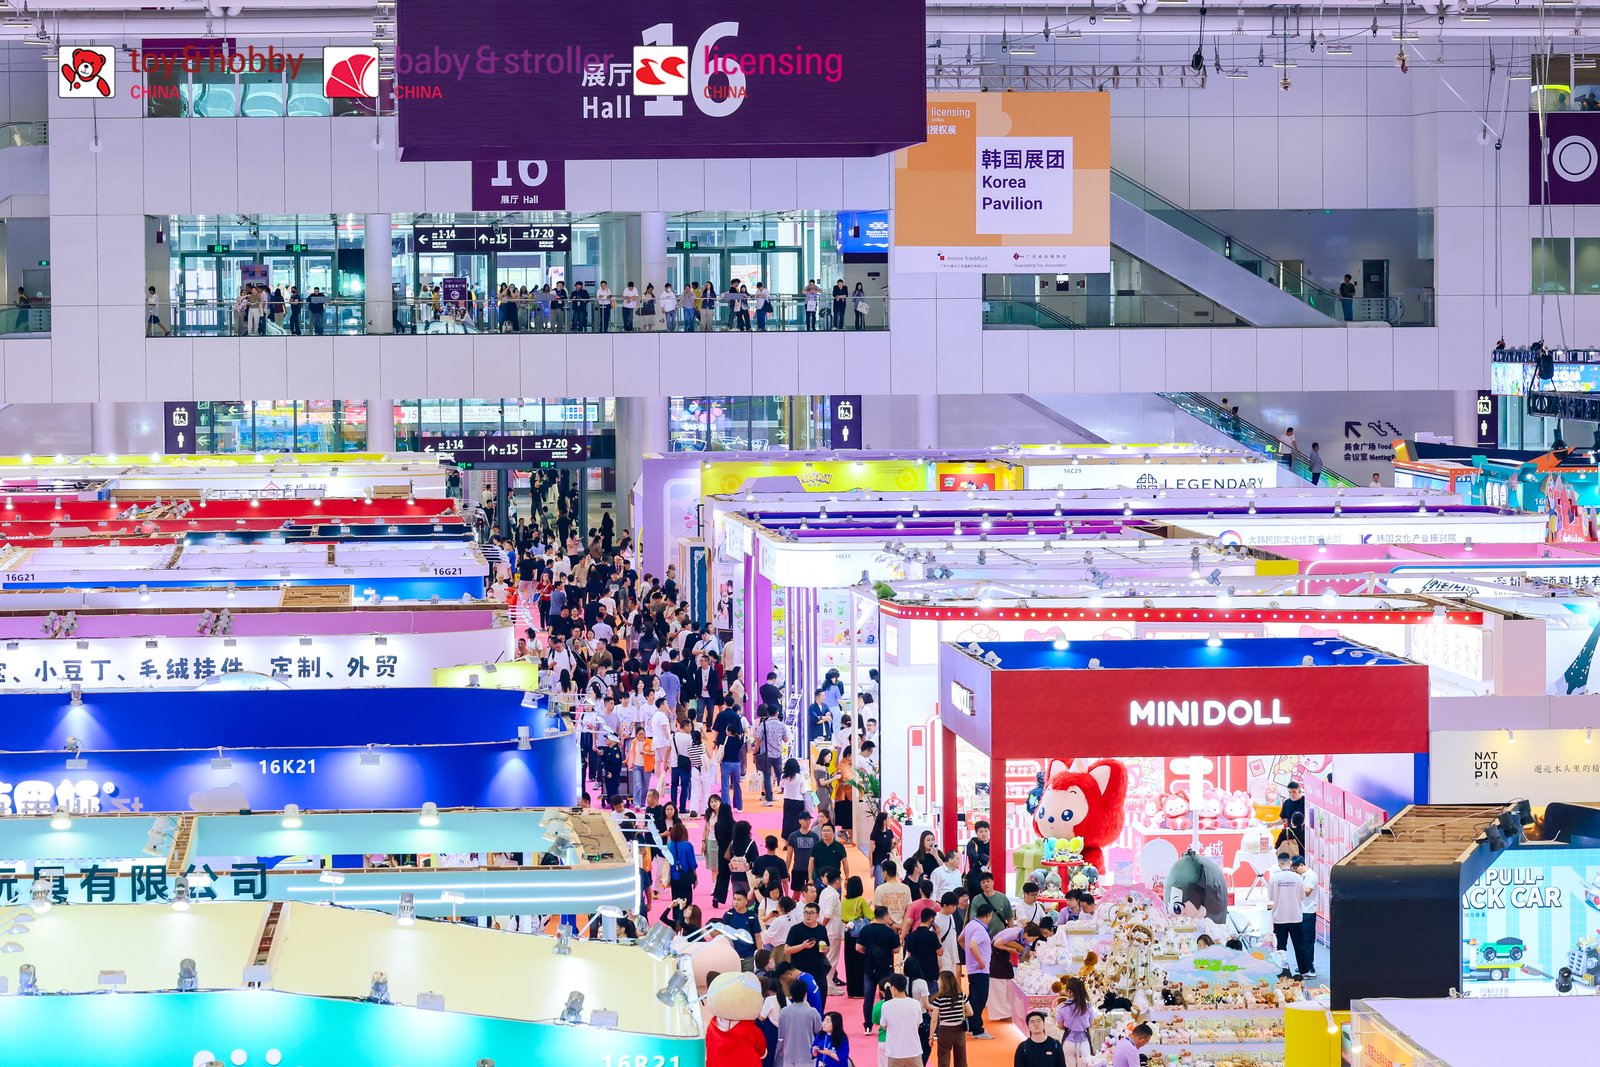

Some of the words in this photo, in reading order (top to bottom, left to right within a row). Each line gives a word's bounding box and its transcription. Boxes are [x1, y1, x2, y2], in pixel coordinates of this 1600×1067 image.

[581, 63, 631, 87] 展厅
[582, 96, 631, 118] Hall
[931, 107, 970, 118] licensing
[927, 125, 957, 135] 授权展
[981, 149, 1065, 170] 韩国展团
[982, 175, 1026, 189] Korea
[523, 195, 539, 204] Hall
[982, 196, 1043, 210] Pavilion
[438, 230, 456, 239] 1-14
[496, 234, 507, 244] 15
[530, 229, 554, 238] 17-20
[446, 440, 464, 449] 1-14
[507, 444, 518, 455] 15
[542, 439, 568, 449] 17-20
[1164, 478, 1264, 490] LEGENDARY
[1474, 752, 1498, 760] NAT
[258, 759, 316, 775] 16K21
[1474, 761, 1498, 770] UTO
[1474, 771, 1498, 780] PIA
[1486, 868, 1544, 886] PULL-
[1510, 887, 1562, 909] CAR
